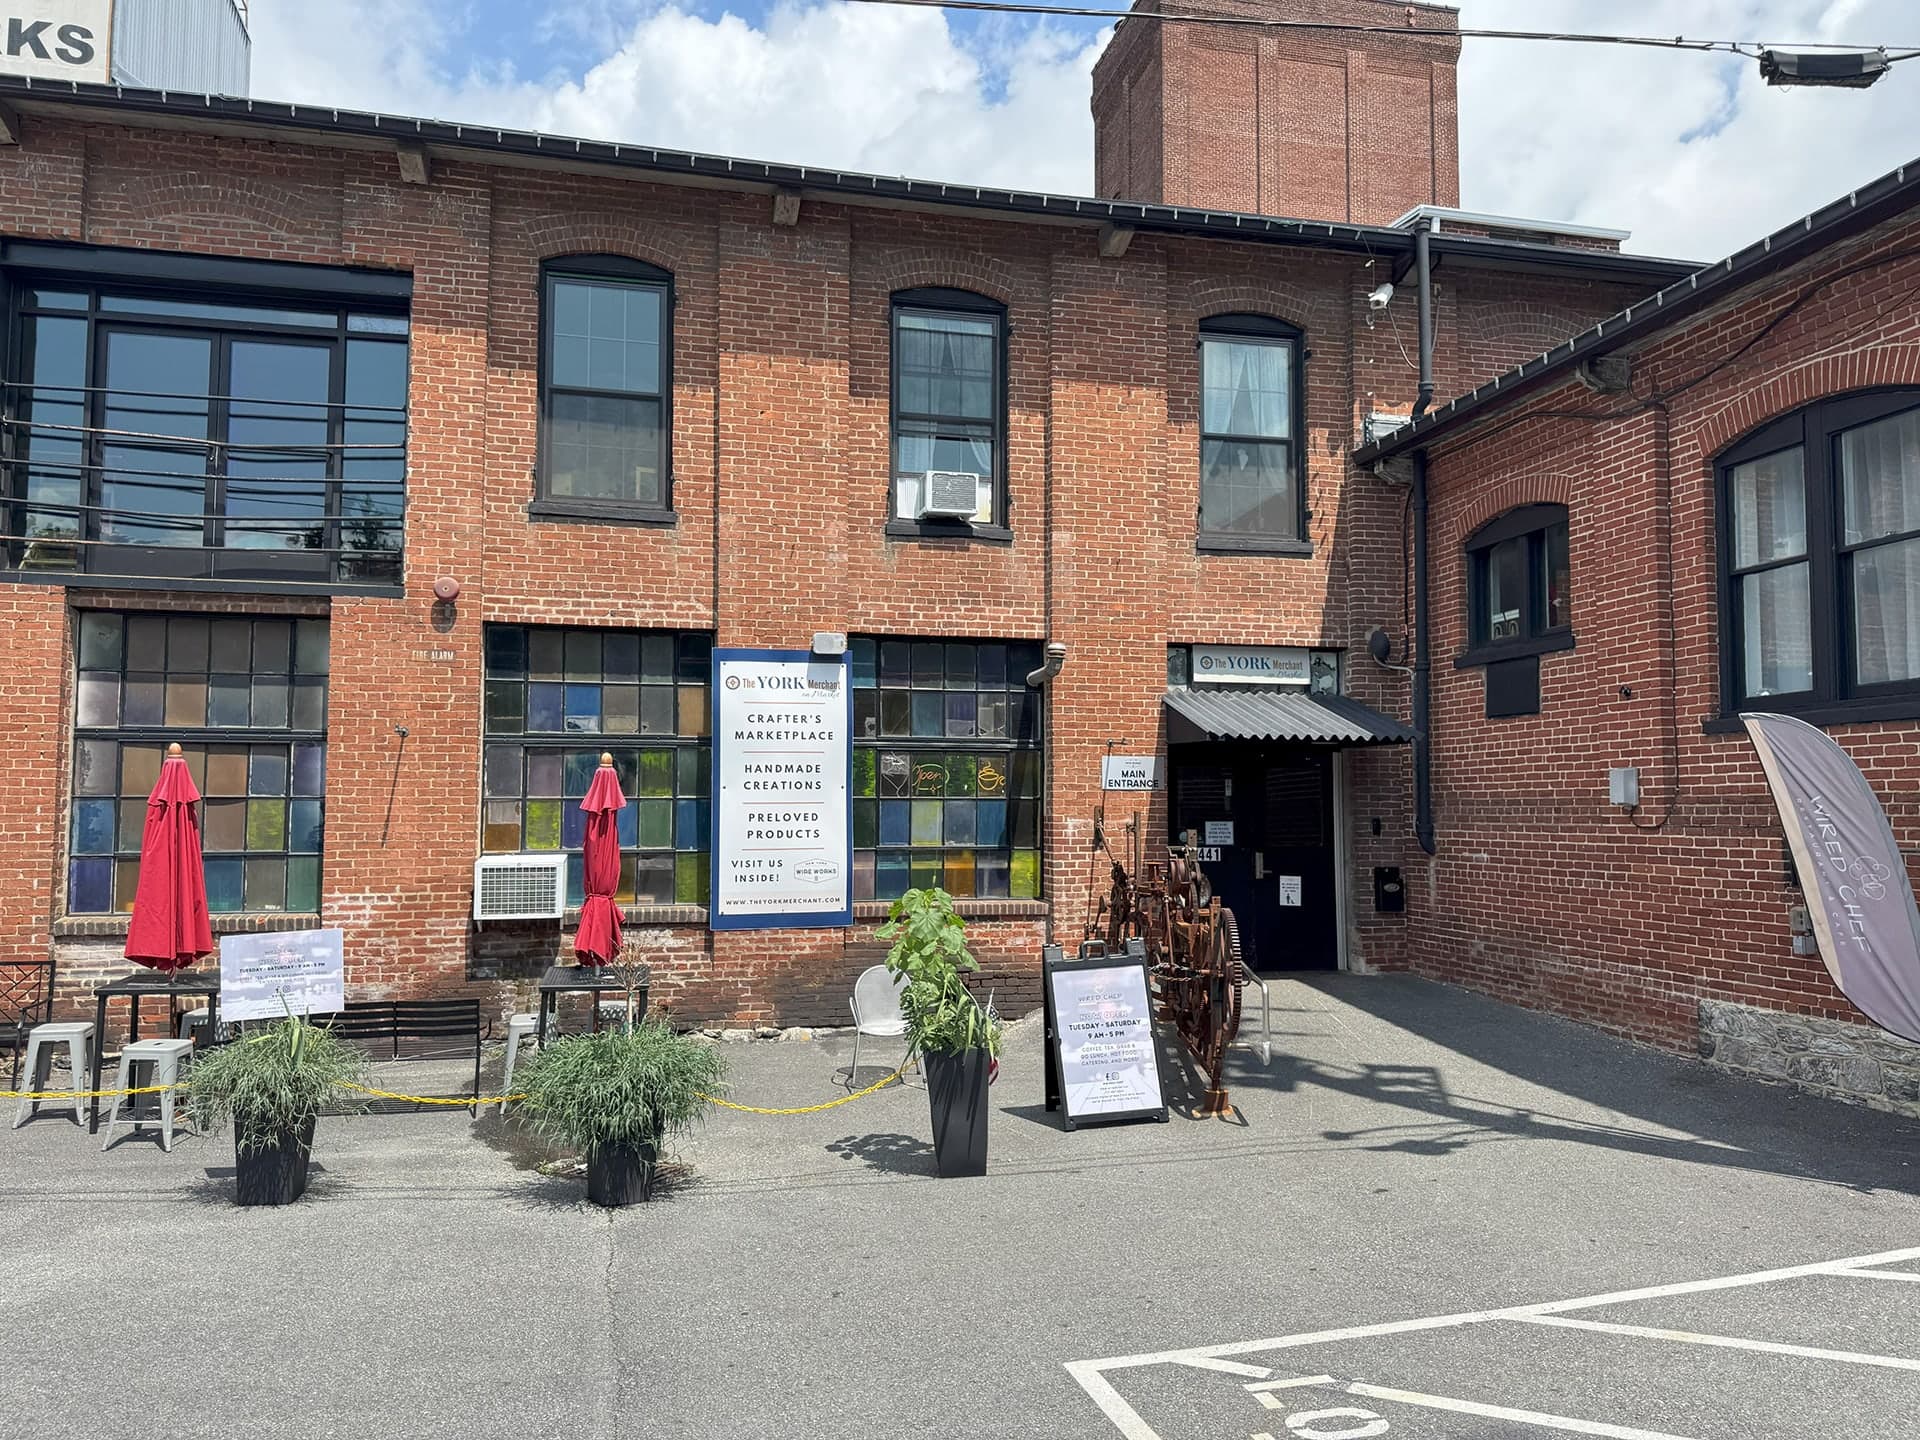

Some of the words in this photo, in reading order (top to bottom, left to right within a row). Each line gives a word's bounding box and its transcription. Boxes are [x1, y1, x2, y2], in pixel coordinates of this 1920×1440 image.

[0, 17, 95, 65] KS
[431, 651, 455, 660] ALARM
[1214, 658, 1227, 669] The
[1227, 656, 1271, 670] YORK
[1272, 659, 1303, 671] Merchant
[743, 678, 756, 689] The
[757, 676, 805, 690] YORK
[808, 679, 841, 691] Merchant
[747, 714, 822, 724] CRAFTER'S
[734, 730, 834, 741] MARKETPLACE
[744, 764, 822, 774] HANDMADE
[1121, 770, 1146, 778] MAIN
[743, 780, 822, 790] CREATIONS
[1108, 779, 1159, 788] ENTRANCE
[748, 813, 819, 822] PRELOVED
[747, 829, 820, 839] PRODUCTS
[731, 860, 763, 868] VISIT
[769, 859, 784, 868] US
[734, 874, 779, 883] INSIDE!
[1809, 795, 1848, 873] WIRED
[1838, 884, 1872, 954] CHEF
[726, 897, 840, 906] WWW.THEYORKMERCHANT.COM
[1068, 1022, 1100, 1031] TUESDAY
[1105, 1019, 1141, 1028] SATURDAY
